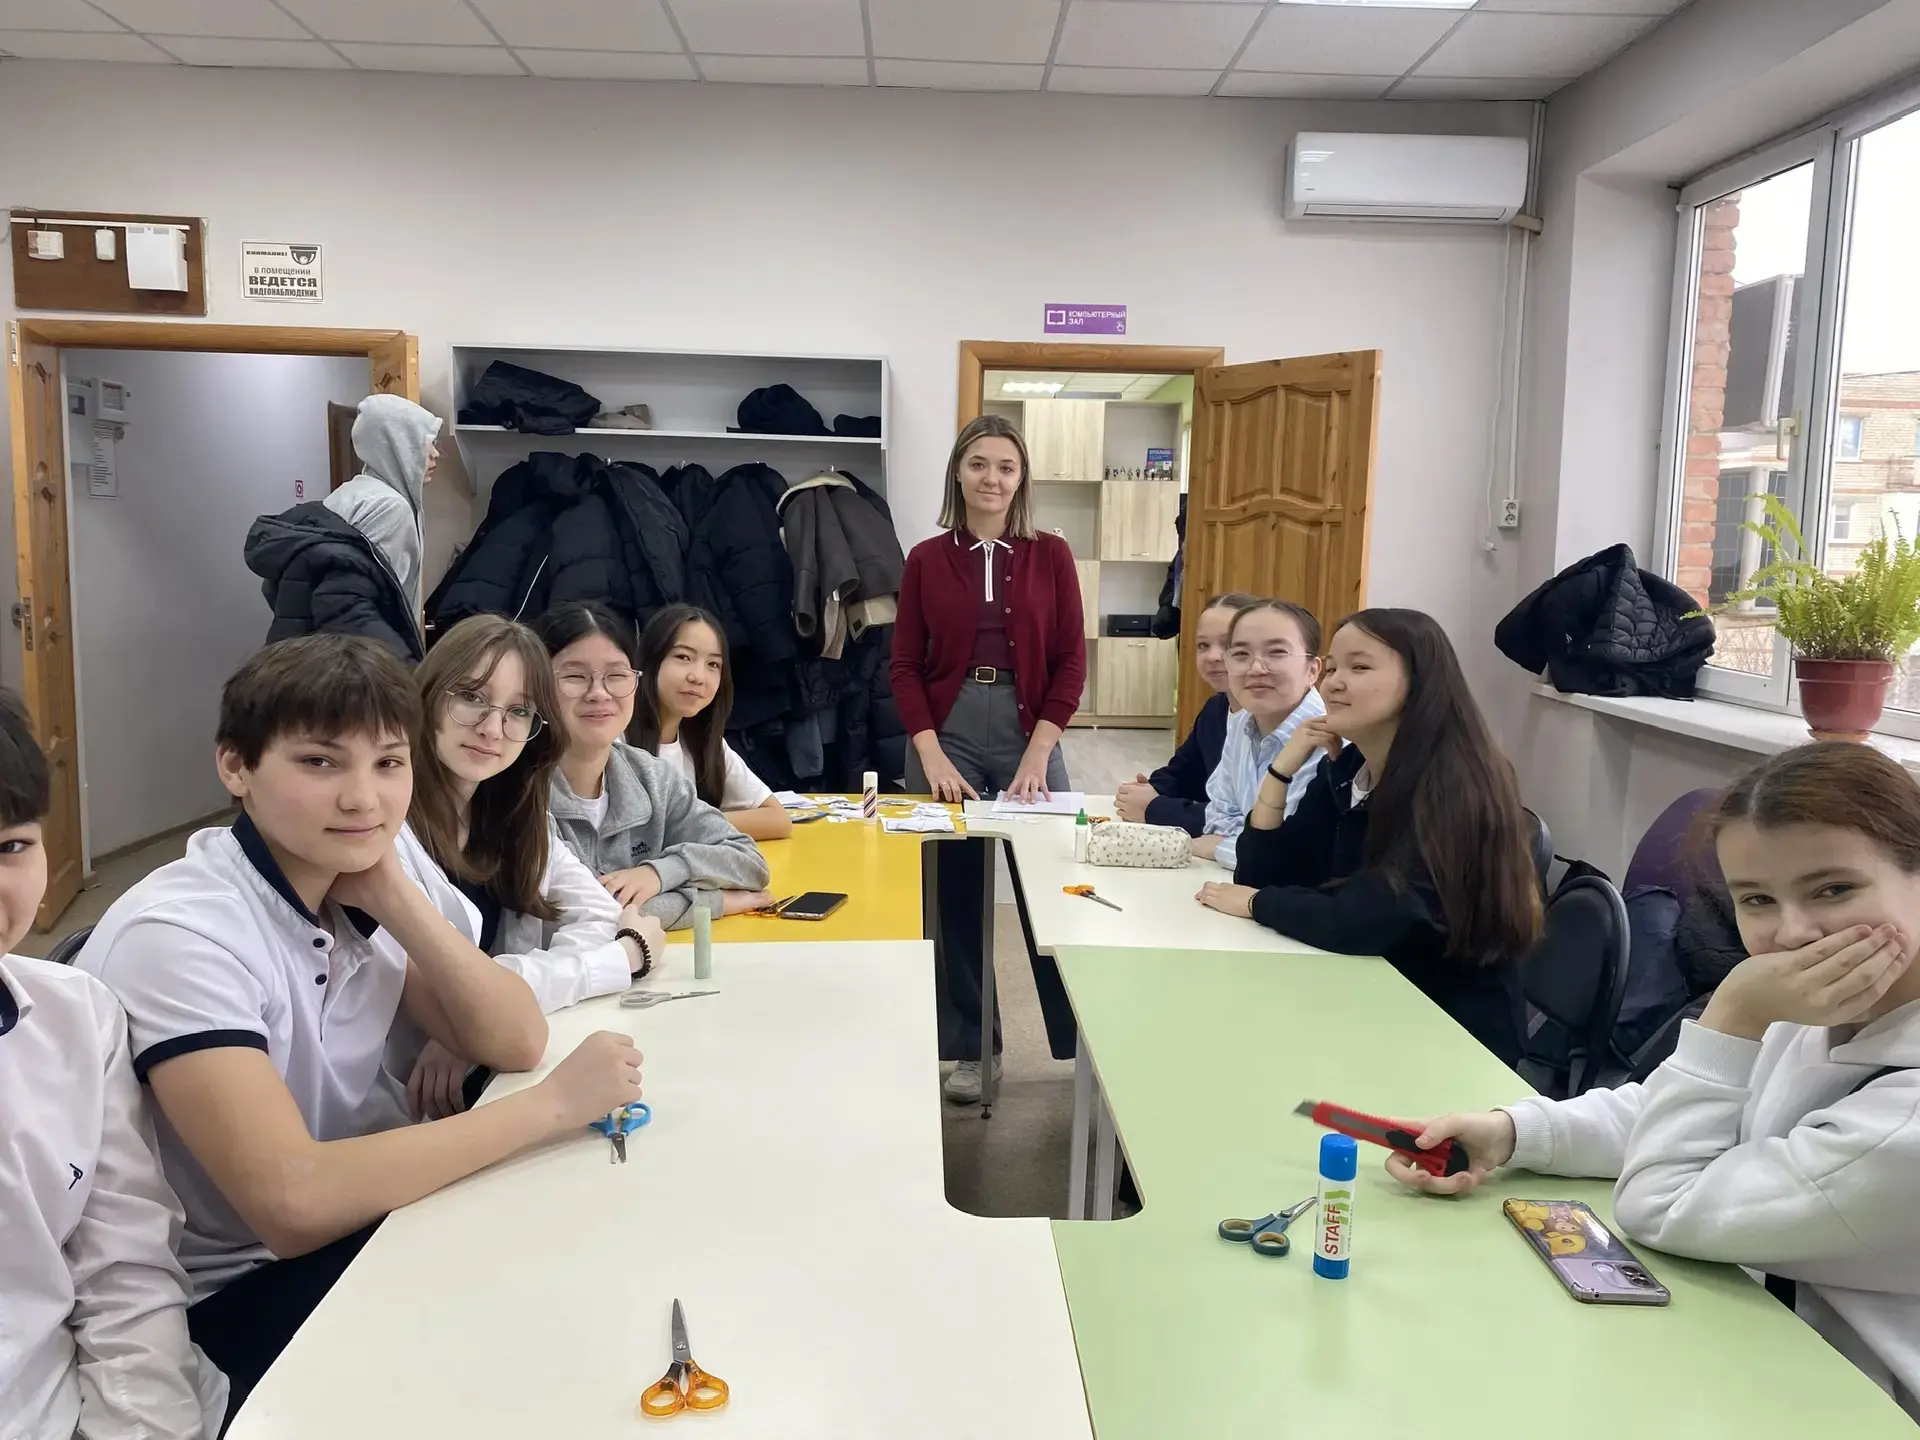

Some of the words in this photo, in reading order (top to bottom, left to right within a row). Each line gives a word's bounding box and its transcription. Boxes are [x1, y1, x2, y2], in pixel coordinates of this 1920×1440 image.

[248, 275, 317, 287] ВЕДЕТСЯ
[249, 287, 317, 297] ВИДЕОНАБЛЮДЕНИЕ
[1068, 310, 1126, 318] КОМПЬЮТЕРНЫЙ
[1324, 1203, 1341, 1255] STAFF
